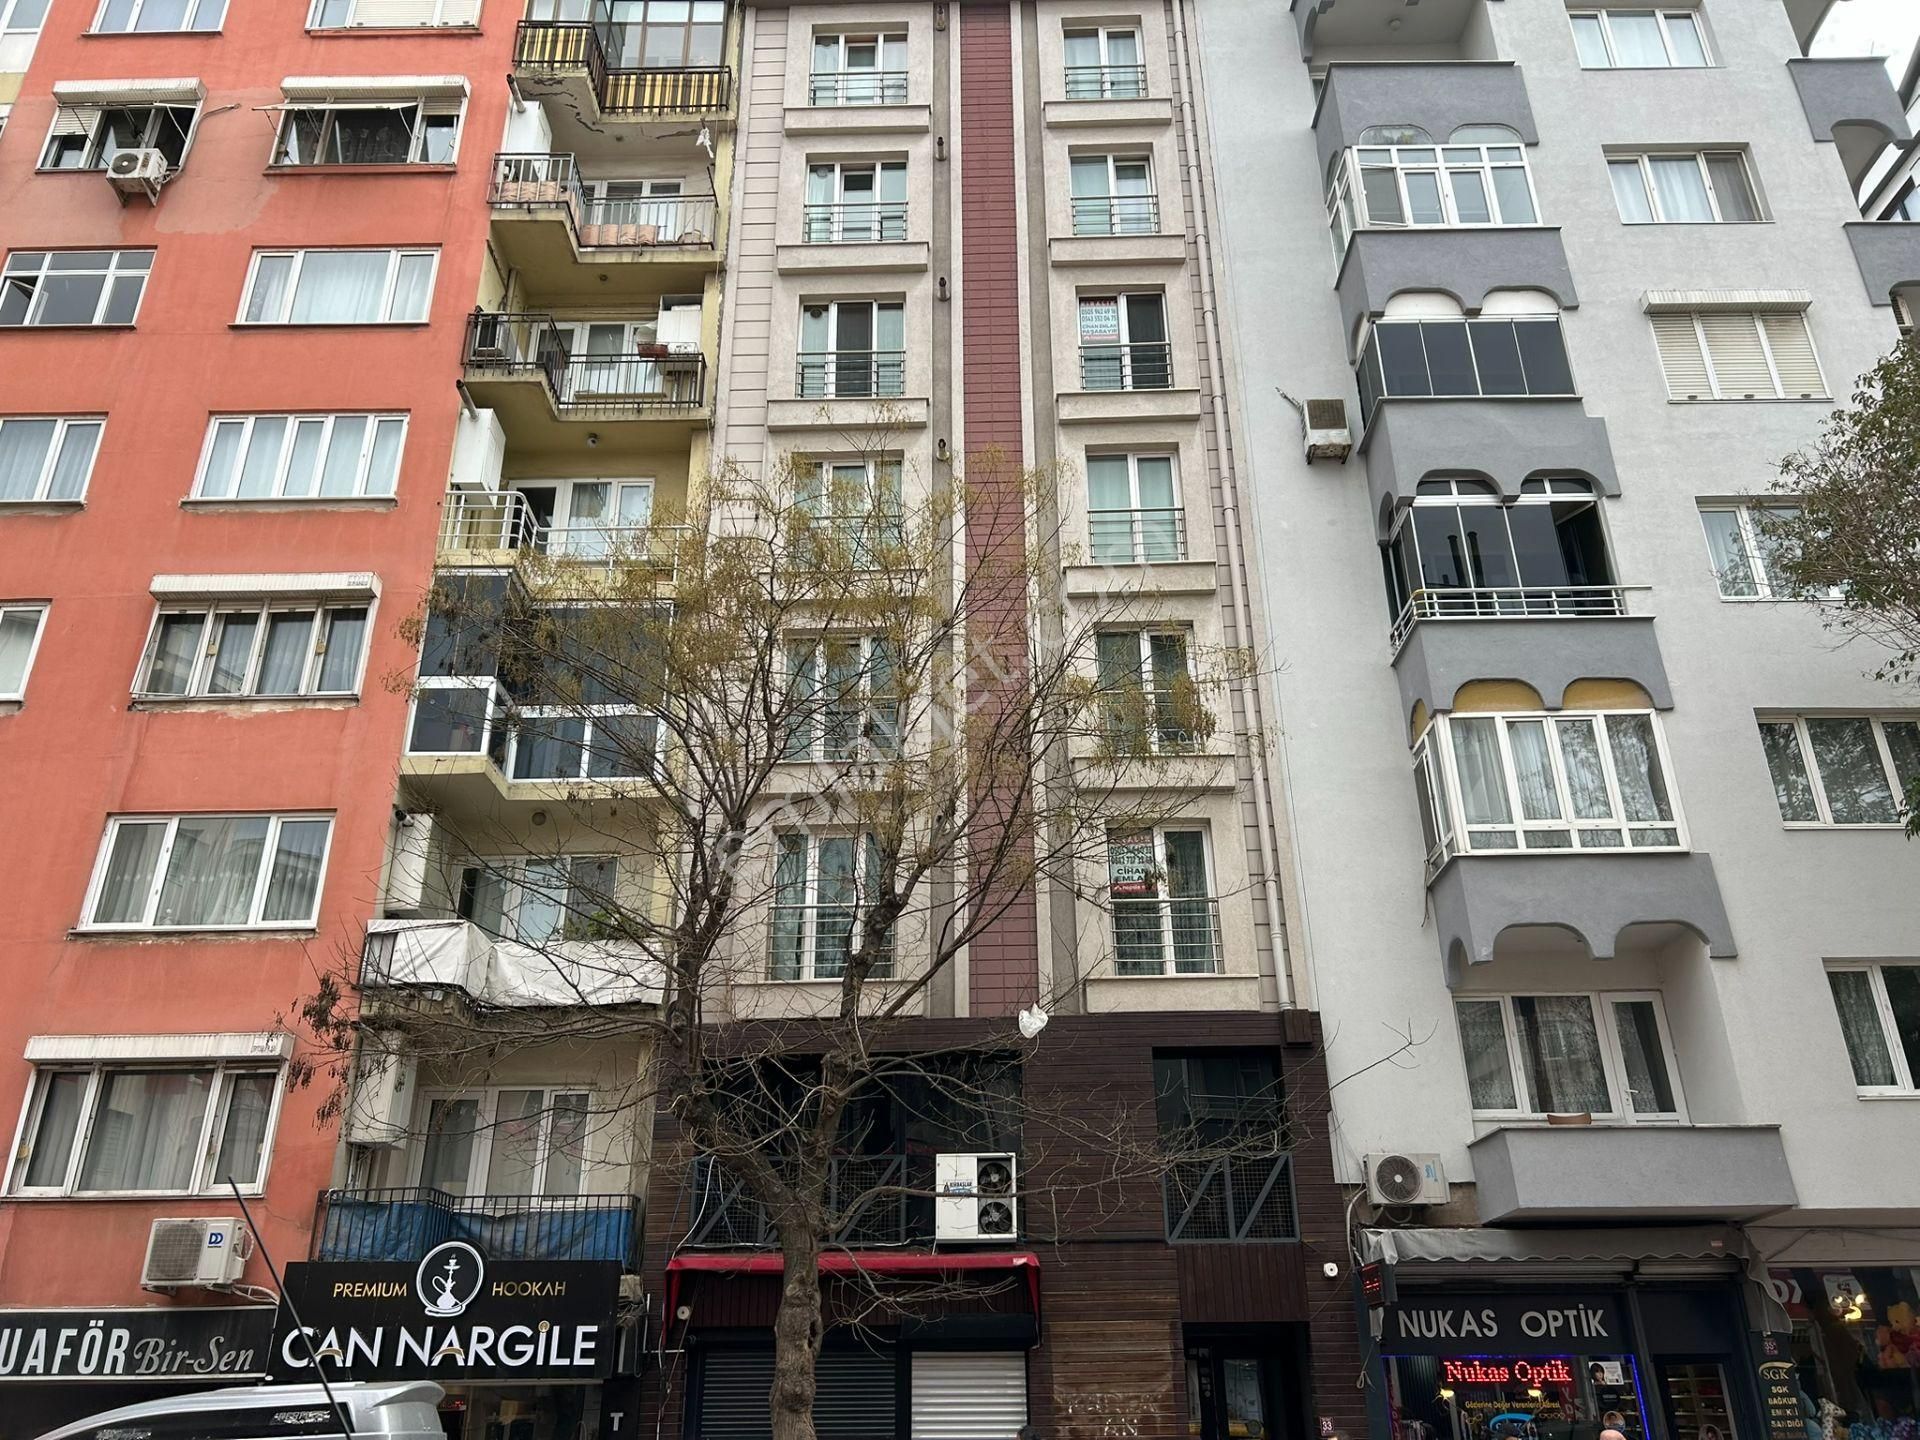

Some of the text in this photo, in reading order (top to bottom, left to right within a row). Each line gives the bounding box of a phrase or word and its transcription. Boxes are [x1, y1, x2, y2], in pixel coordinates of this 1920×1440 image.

[333, 1281, 566, 1298] PREMIUM HOOKAH
[1397, 1304, 1609, 1338] NUKAS OPTİK
[133, 1335, 255, 1374] Bir-Sen
[282, 1321, 598, 1368] CAN NARGİLE
[1444, 1360, 1572, 1387] Nukas Optik
[1763, 1368, 1789, 1381] SGK
[1322, 1421, 1333, 1431] 33
